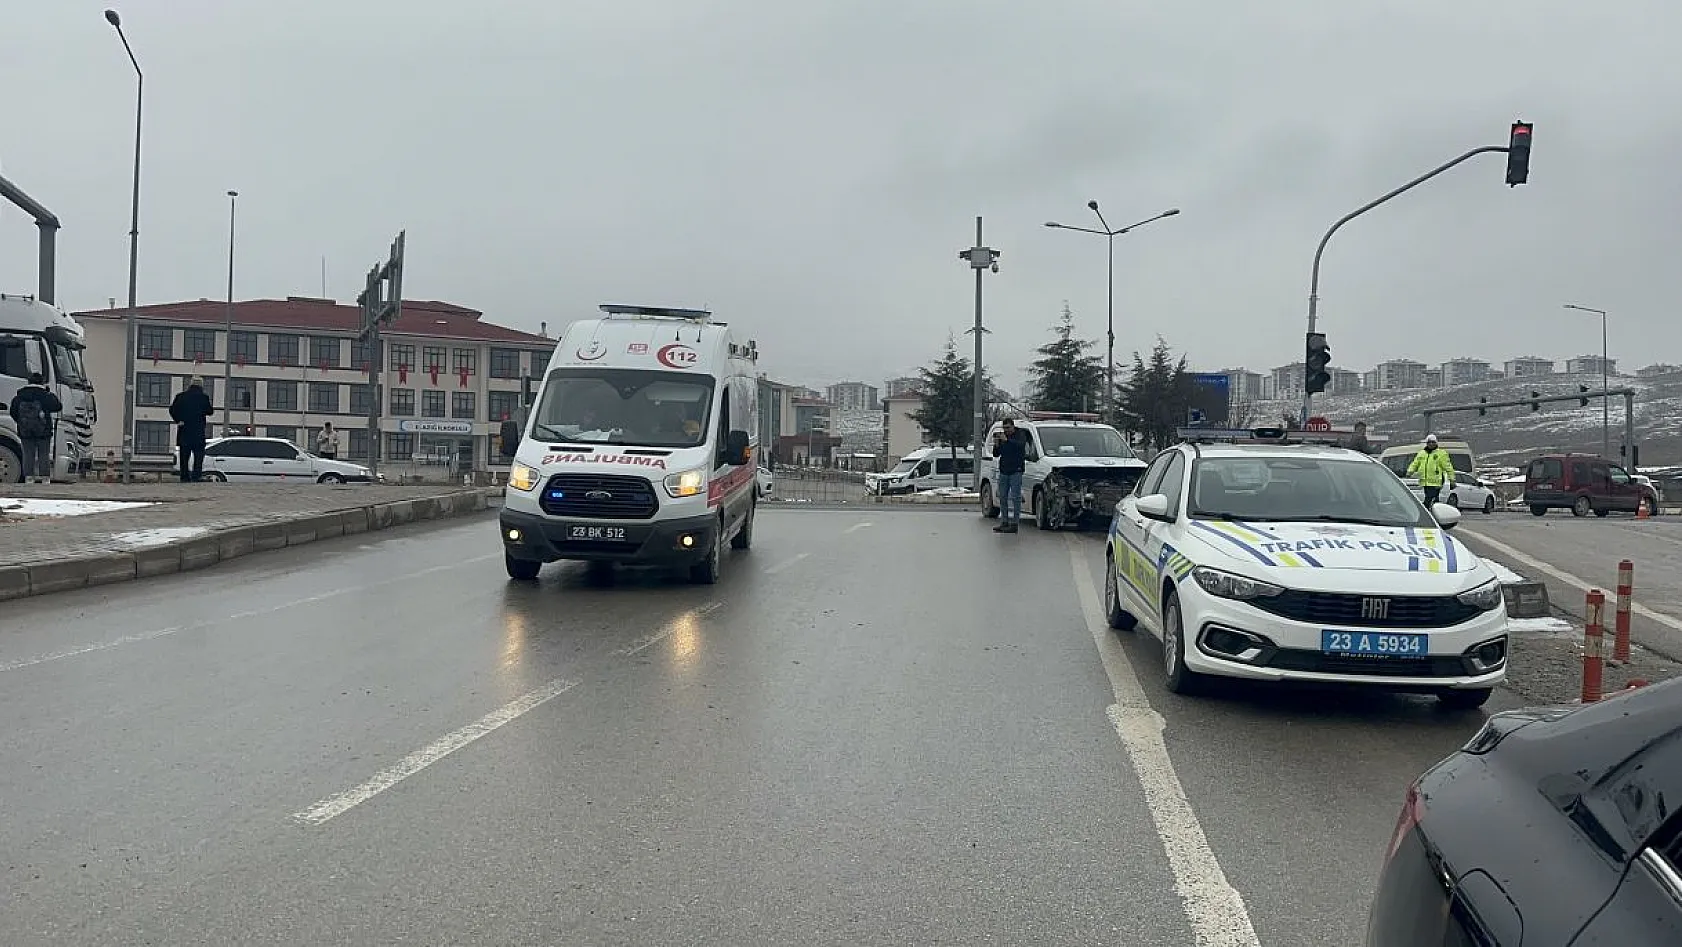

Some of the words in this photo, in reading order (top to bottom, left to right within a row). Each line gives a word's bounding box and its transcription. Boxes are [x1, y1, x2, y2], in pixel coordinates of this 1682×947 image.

[667, 351, 697, 363] 112
[572, 526, 585, 537] 23
[588, 526, 602, 538] BK
[607, 528, 625, 538] 512
[1361, 597, 1392, 619] FIAT
[1329, 633, 1352, 650] 23
[1358, 634, 1371, 651] A
[1377, 635, 1421, 653] 5934
